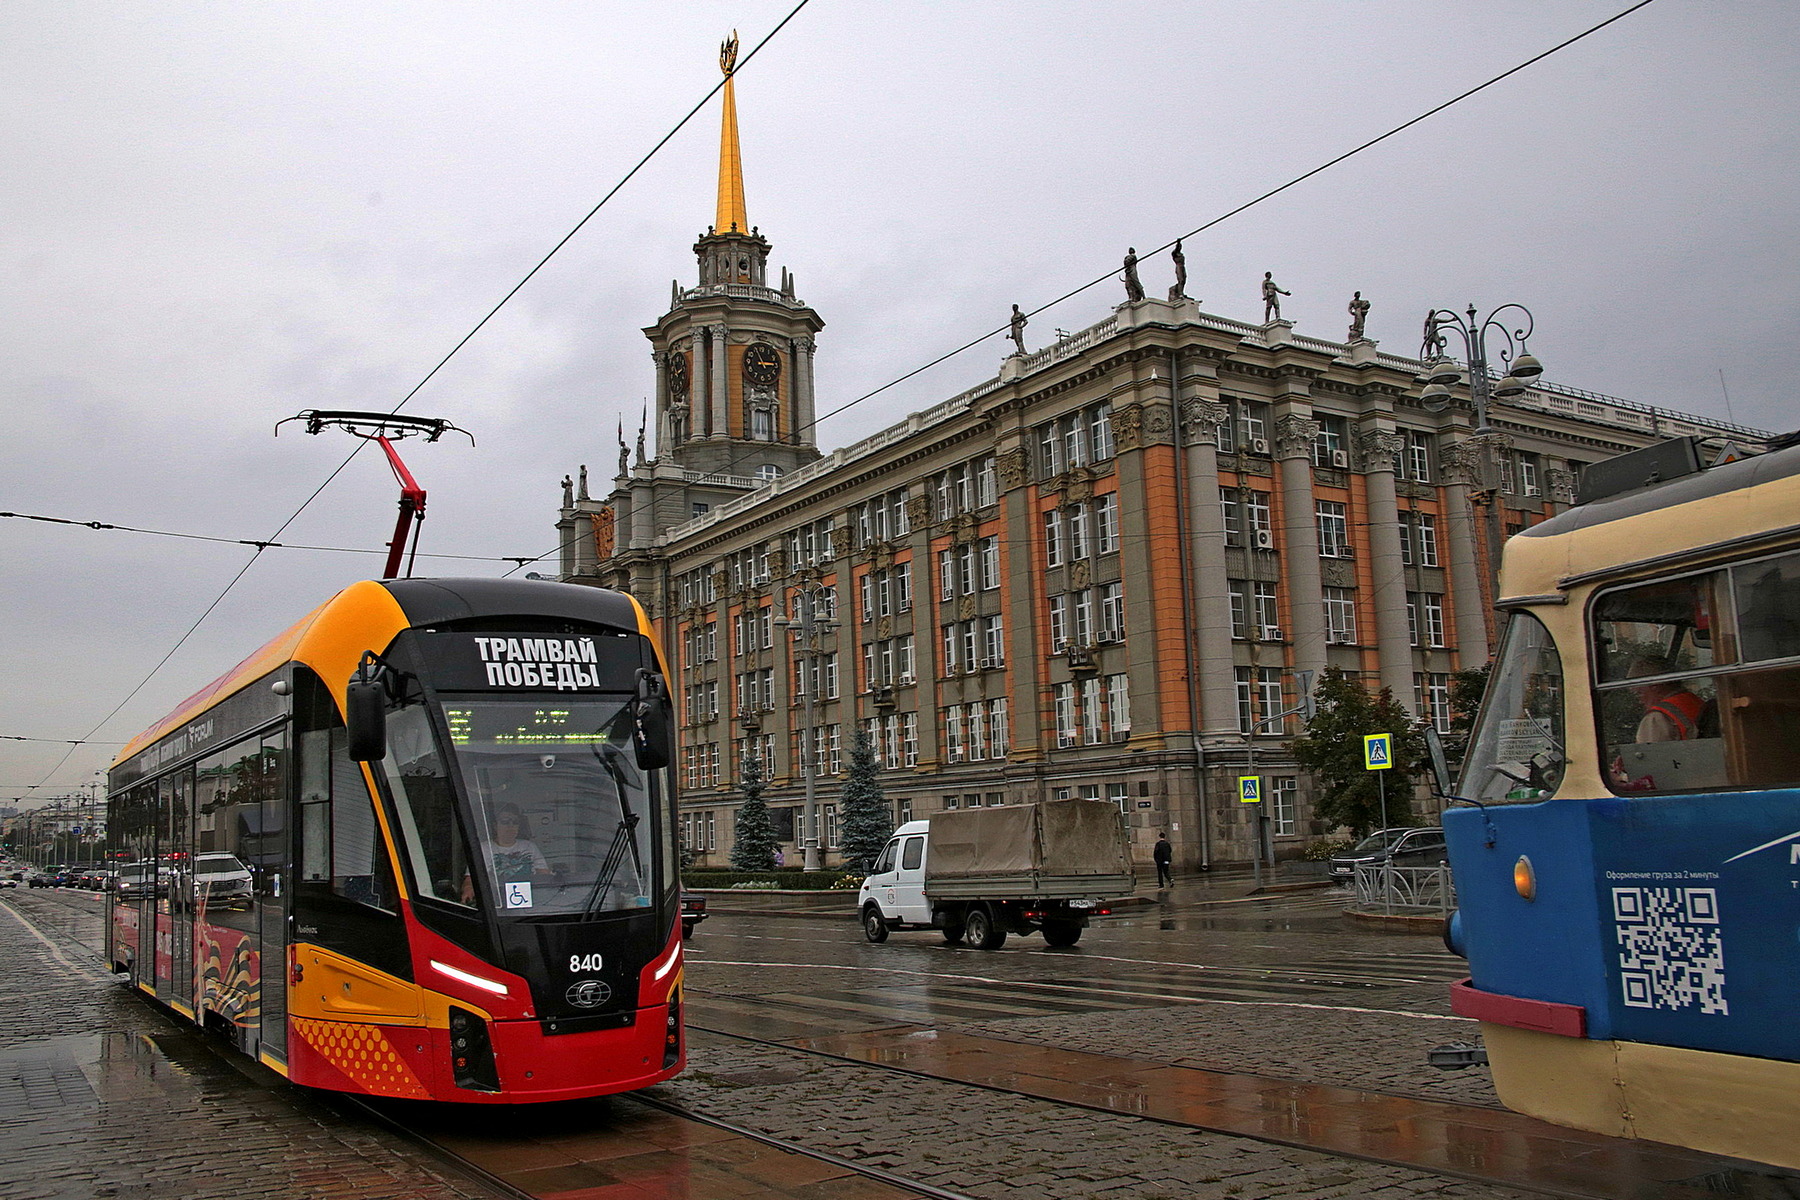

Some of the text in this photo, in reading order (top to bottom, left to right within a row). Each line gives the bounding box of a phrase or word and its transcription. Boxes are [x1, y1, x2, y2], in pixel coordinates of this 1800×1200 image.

[474, 637, 598, 663] ТРАМВАЙ
[485, 662, 600, 691] ПОБЕДЫ
[1606, 870, 1651, 880] Оформление
[1652, 872, 1672, 880] груза
[1684, 870, 1689, 879] 2
[1690, 872, 1719, 880] минуты
[569, 953, 603, 973] 840
